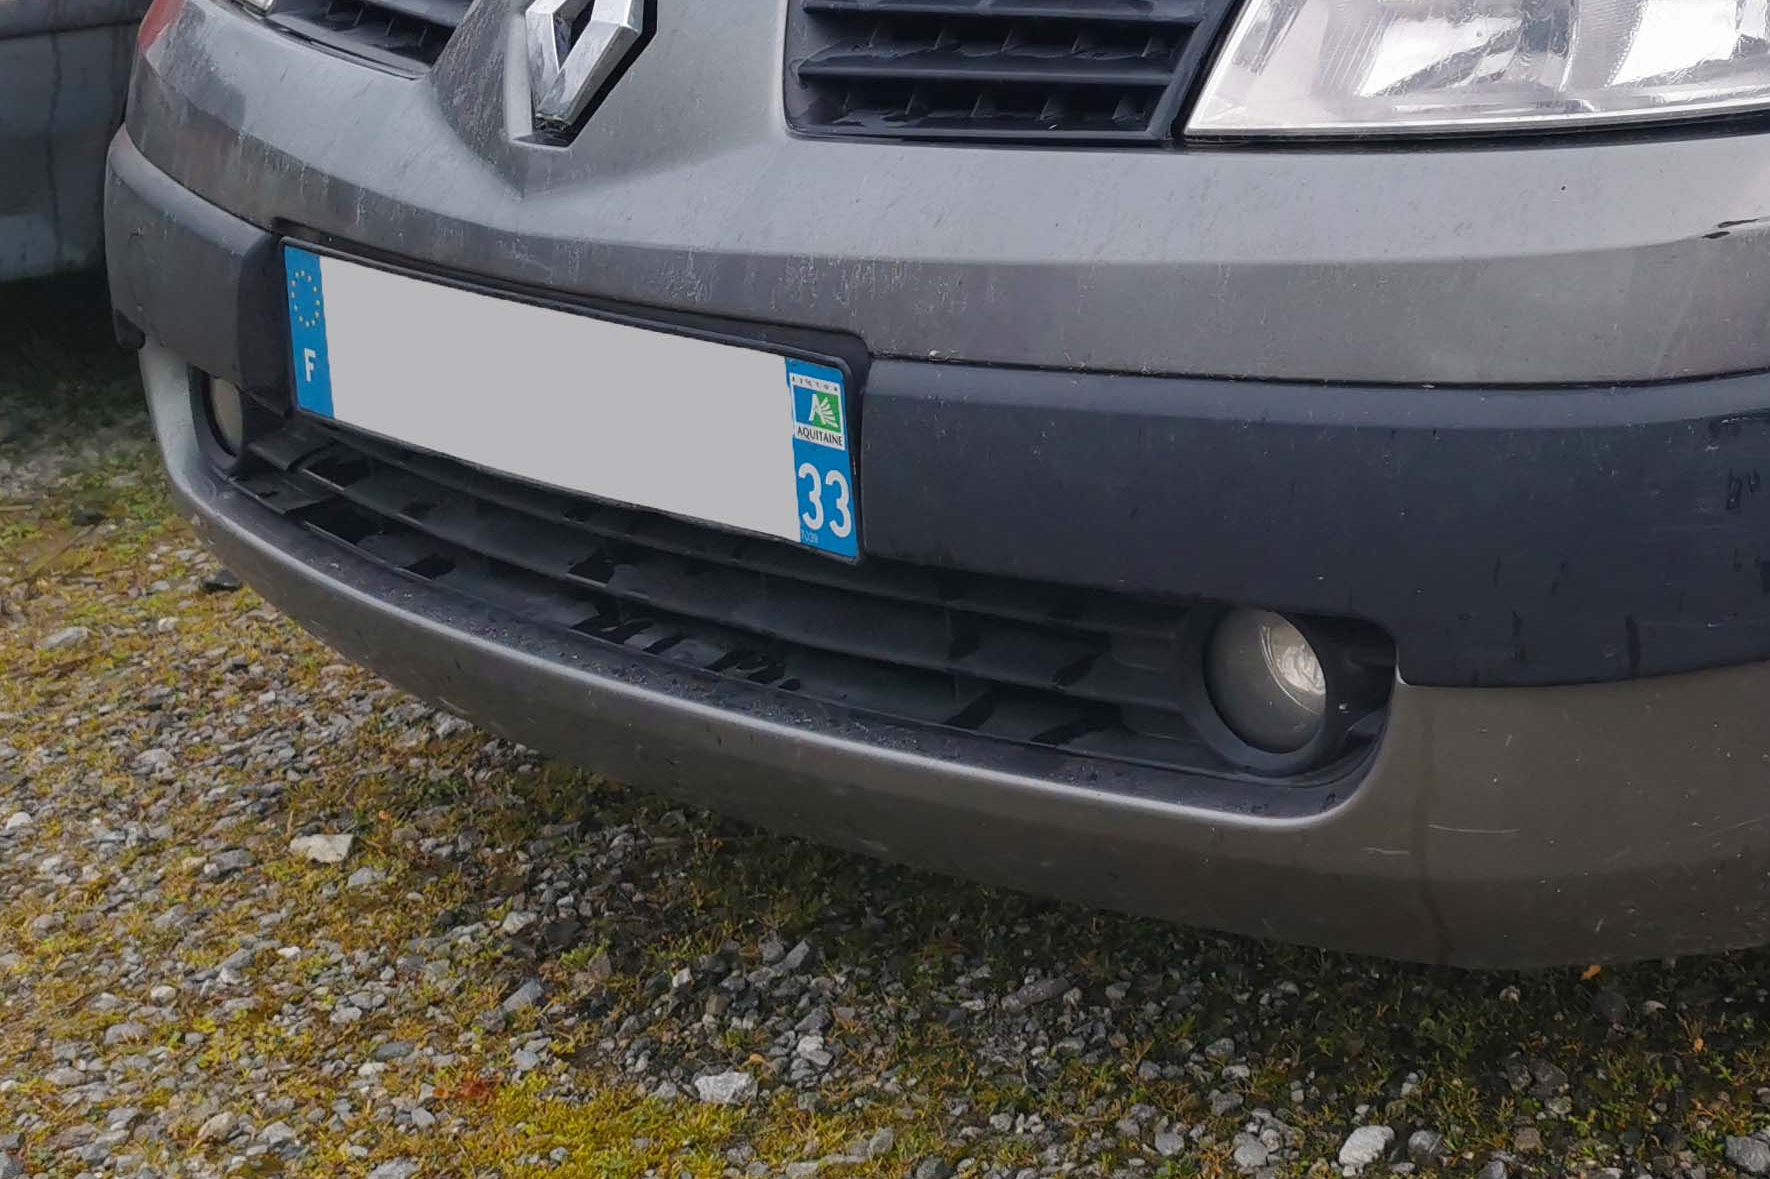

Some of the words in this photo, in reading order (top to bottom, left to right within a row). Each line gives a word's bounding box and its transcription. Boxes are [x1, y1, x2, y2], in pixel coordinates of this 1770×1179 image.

[303, 347, 317, 382] F
[797, 425, 844, 447] AQUITAINE
[798, 462, 852, 538] 33
